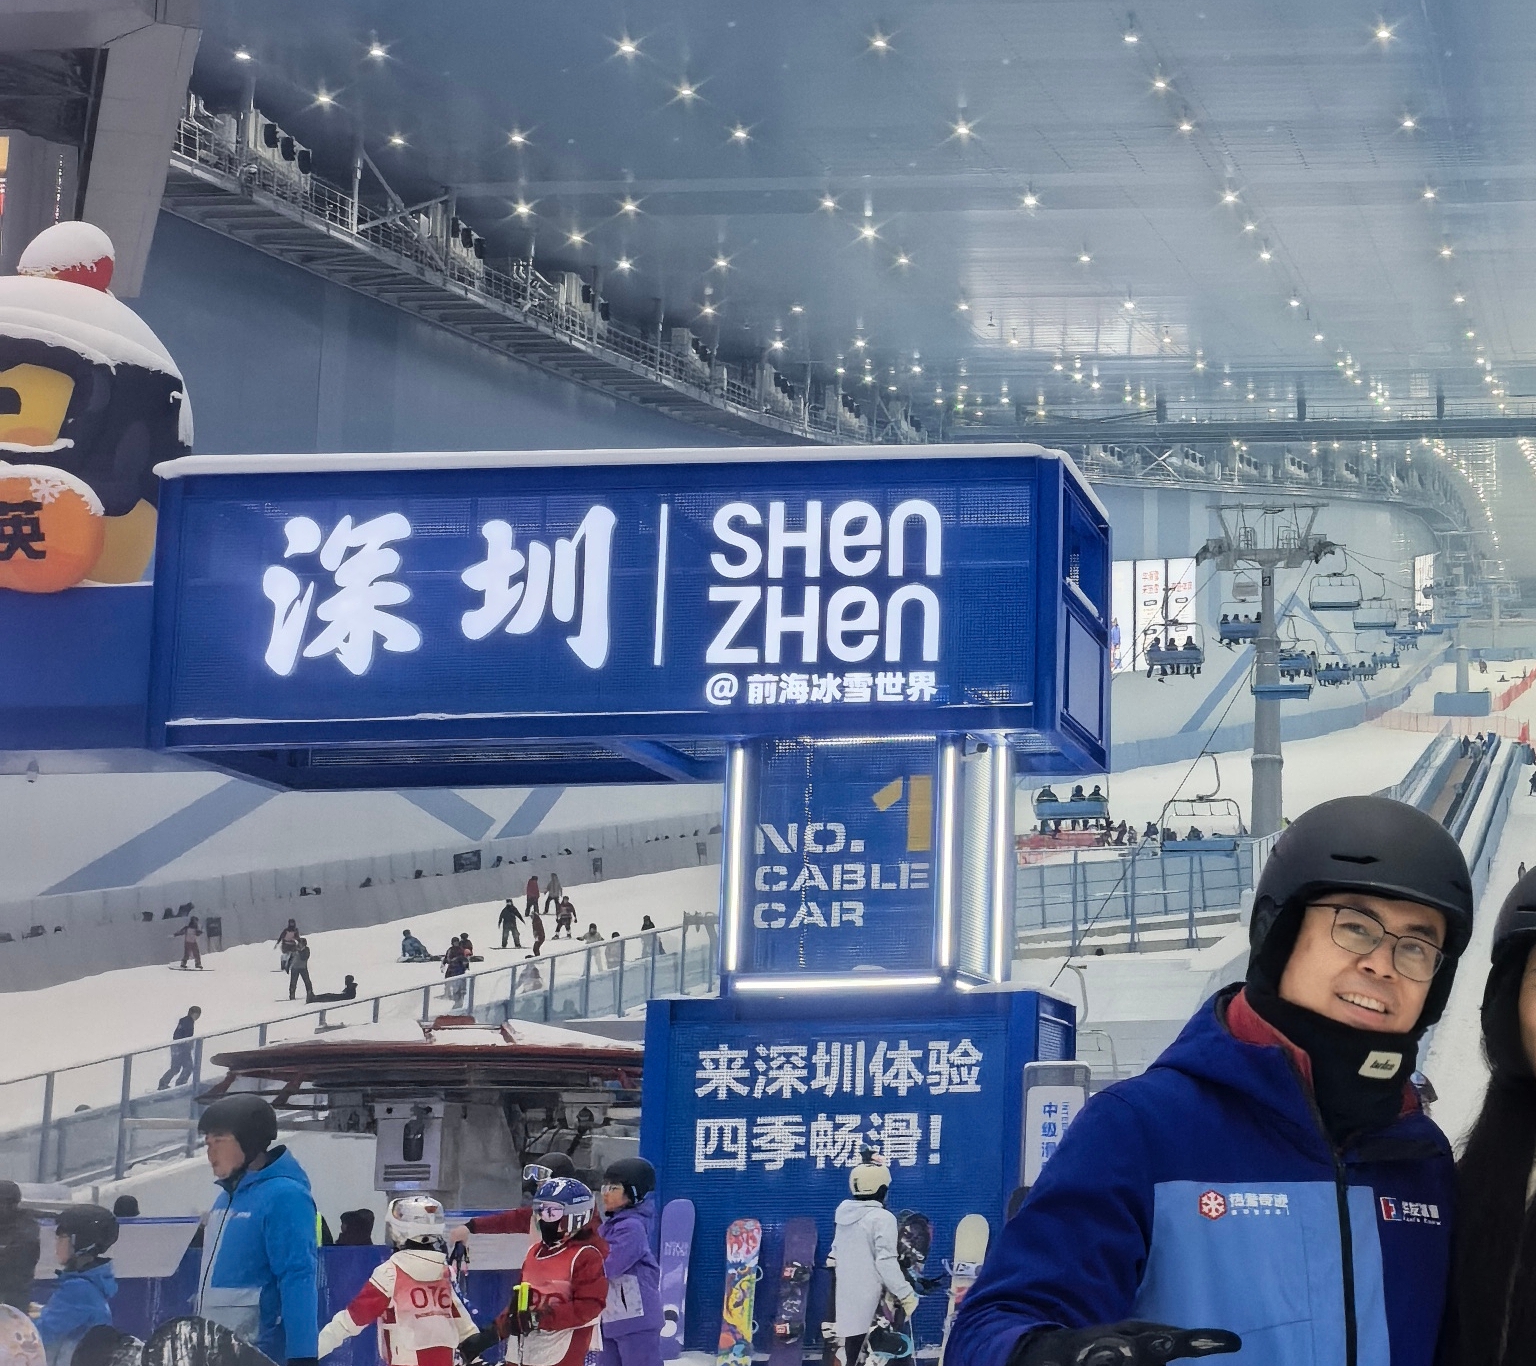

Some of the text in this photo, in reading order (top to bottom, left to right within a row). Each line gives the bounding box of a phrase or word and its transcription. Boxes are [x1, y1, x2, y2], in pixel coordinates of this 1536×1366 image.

[0, 500, 46, 561] 英
[262, 505, 617, 676] 深圳
[746, 670, 938, 704] 前海冰雪世界
[755, 775, 932, 854] NO. 1
[754, 863, 930, 892] CABLE
[753, 901, 865, 929] CAR
[694, 1038, 984, 1100] 来深圳体验
